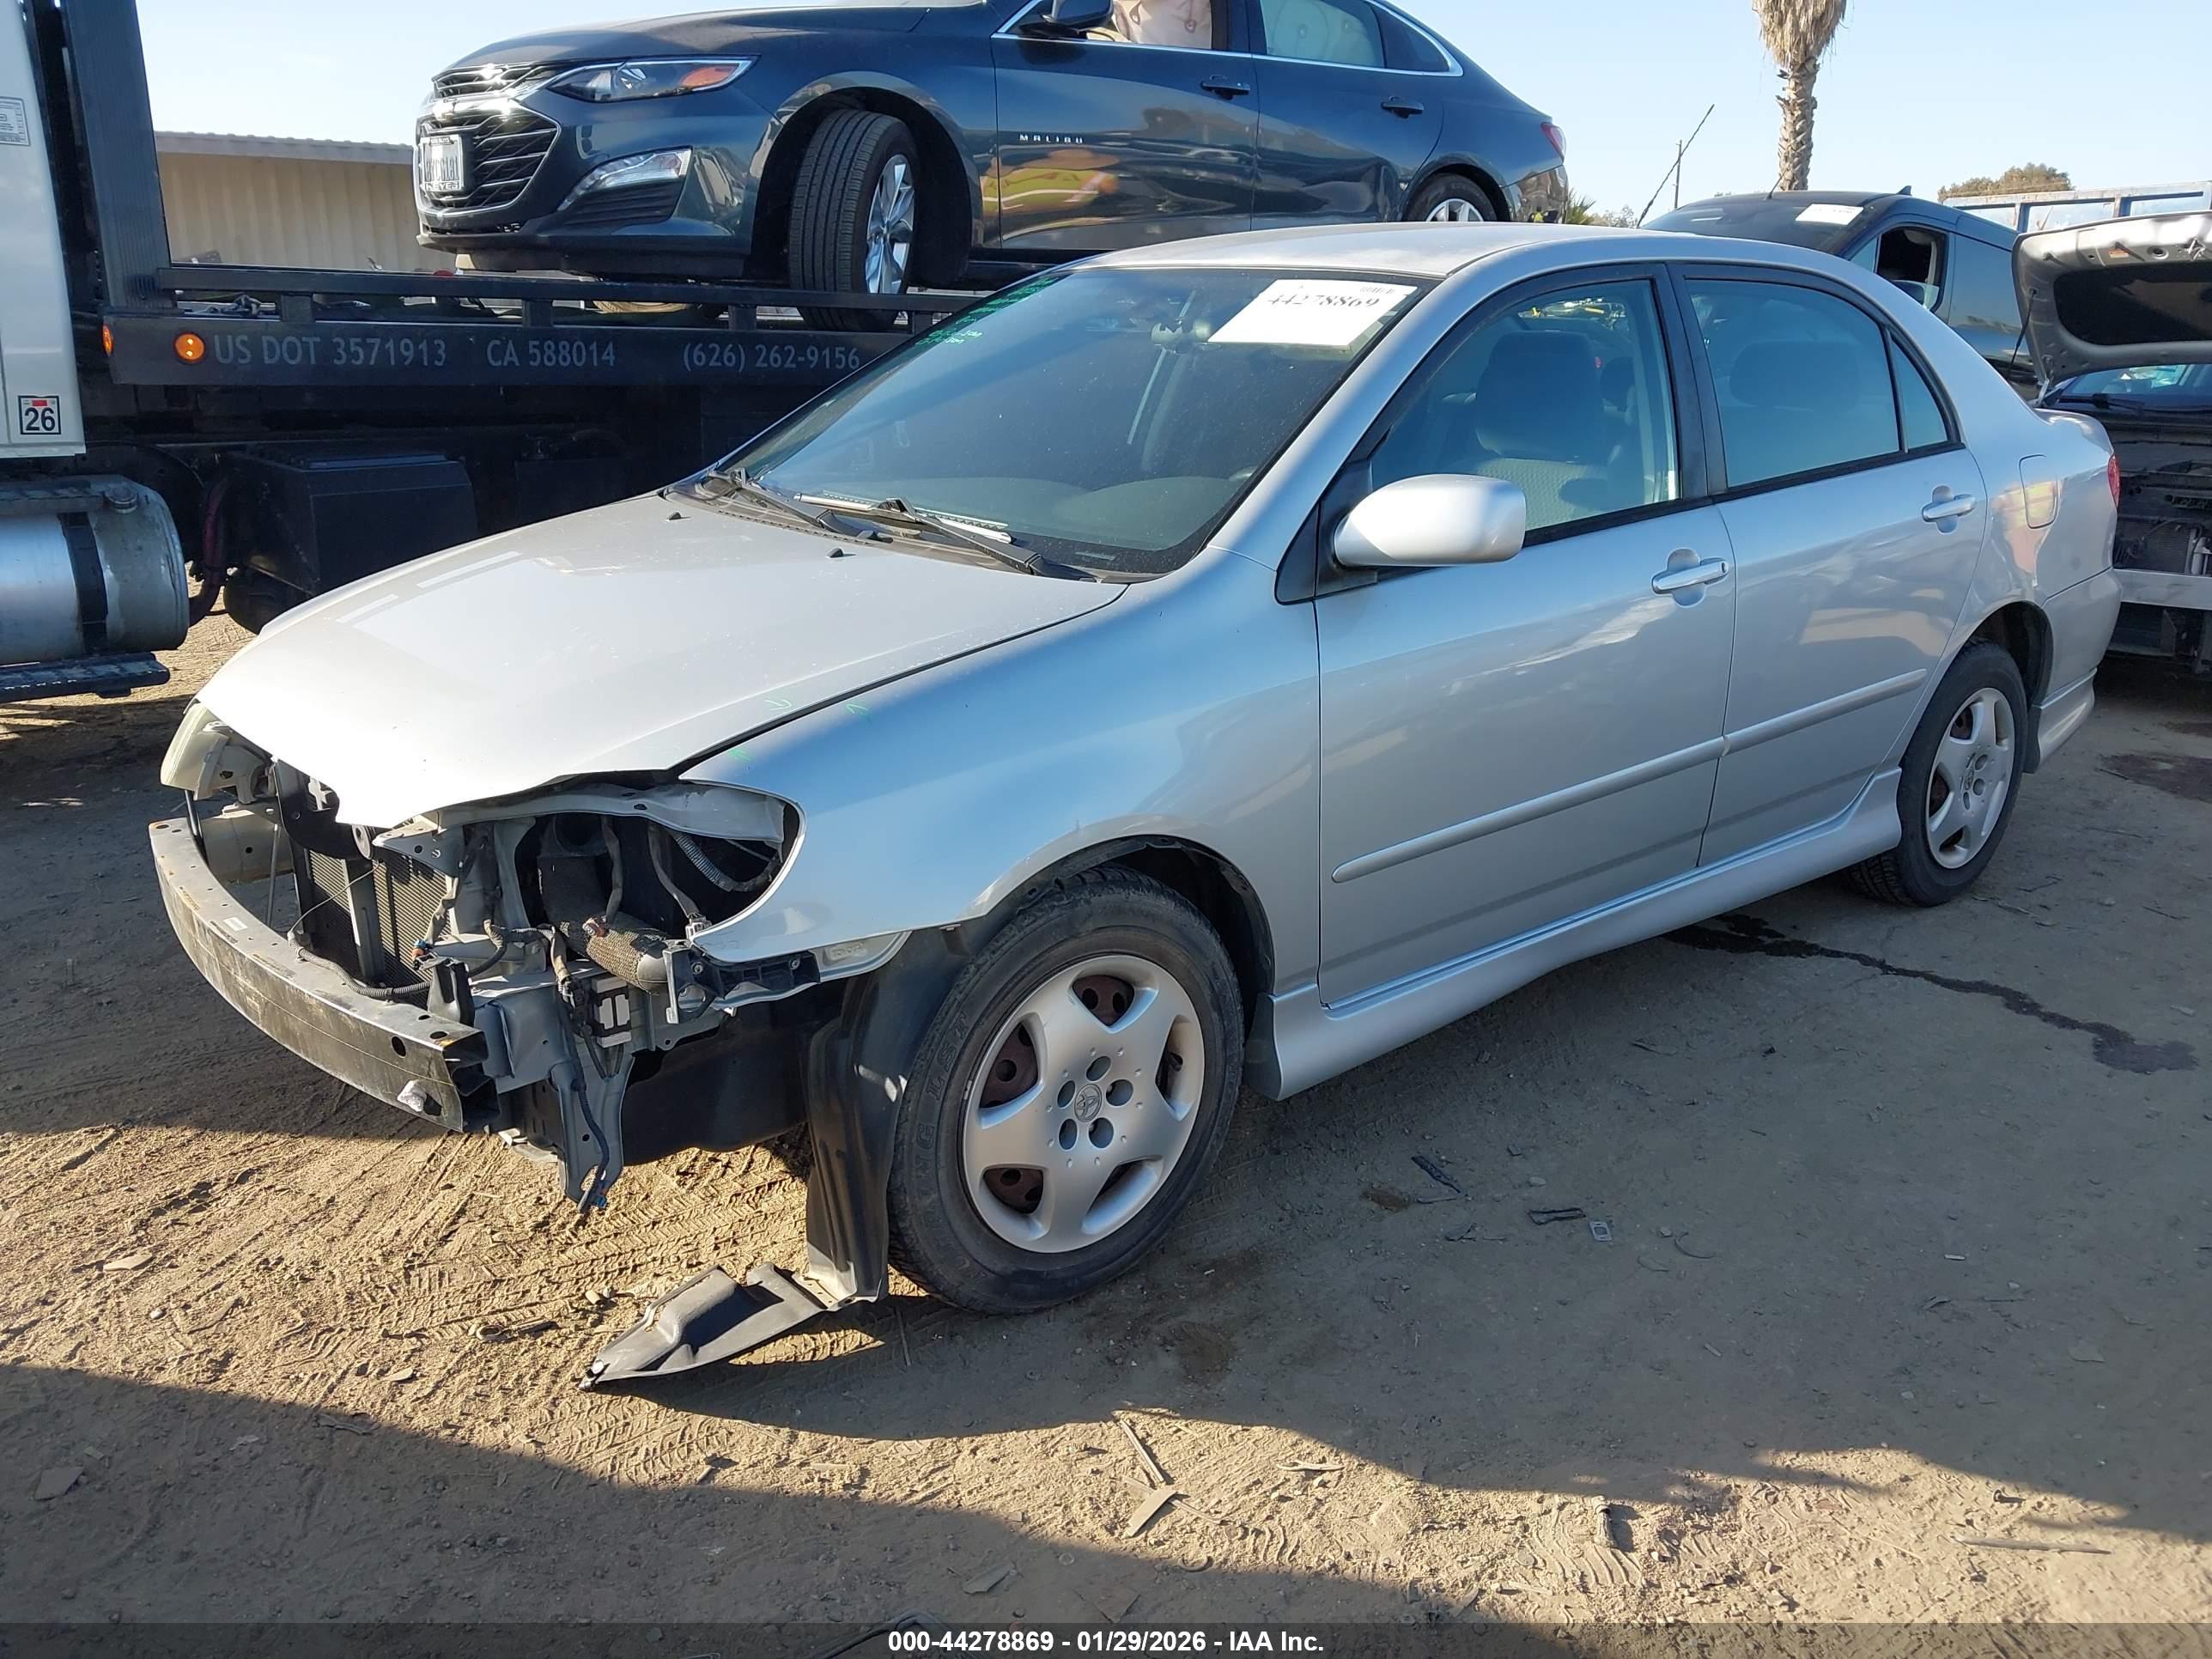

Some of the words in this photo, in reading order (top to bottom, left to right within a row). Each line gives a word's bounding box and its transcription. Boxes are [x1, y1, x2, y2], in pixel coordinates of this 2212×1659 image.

[1019, 134, 1083, 143] MALIBU
[1267, 294, 1379, 307] 44278869
[214, 335, 252, 364] US
[263, 336, 320, 364] DOT
[332, 337, 447, 367] 3571913
[486, 340, 520, 367] CA
[528, 339, 616, 368] 588014
[684, 343, 745, 372] (626)
[755, 344, 860, 370] 262-9156
[25, 407, 56, 431] 26
[926, 1010, 970, 1102] LST
